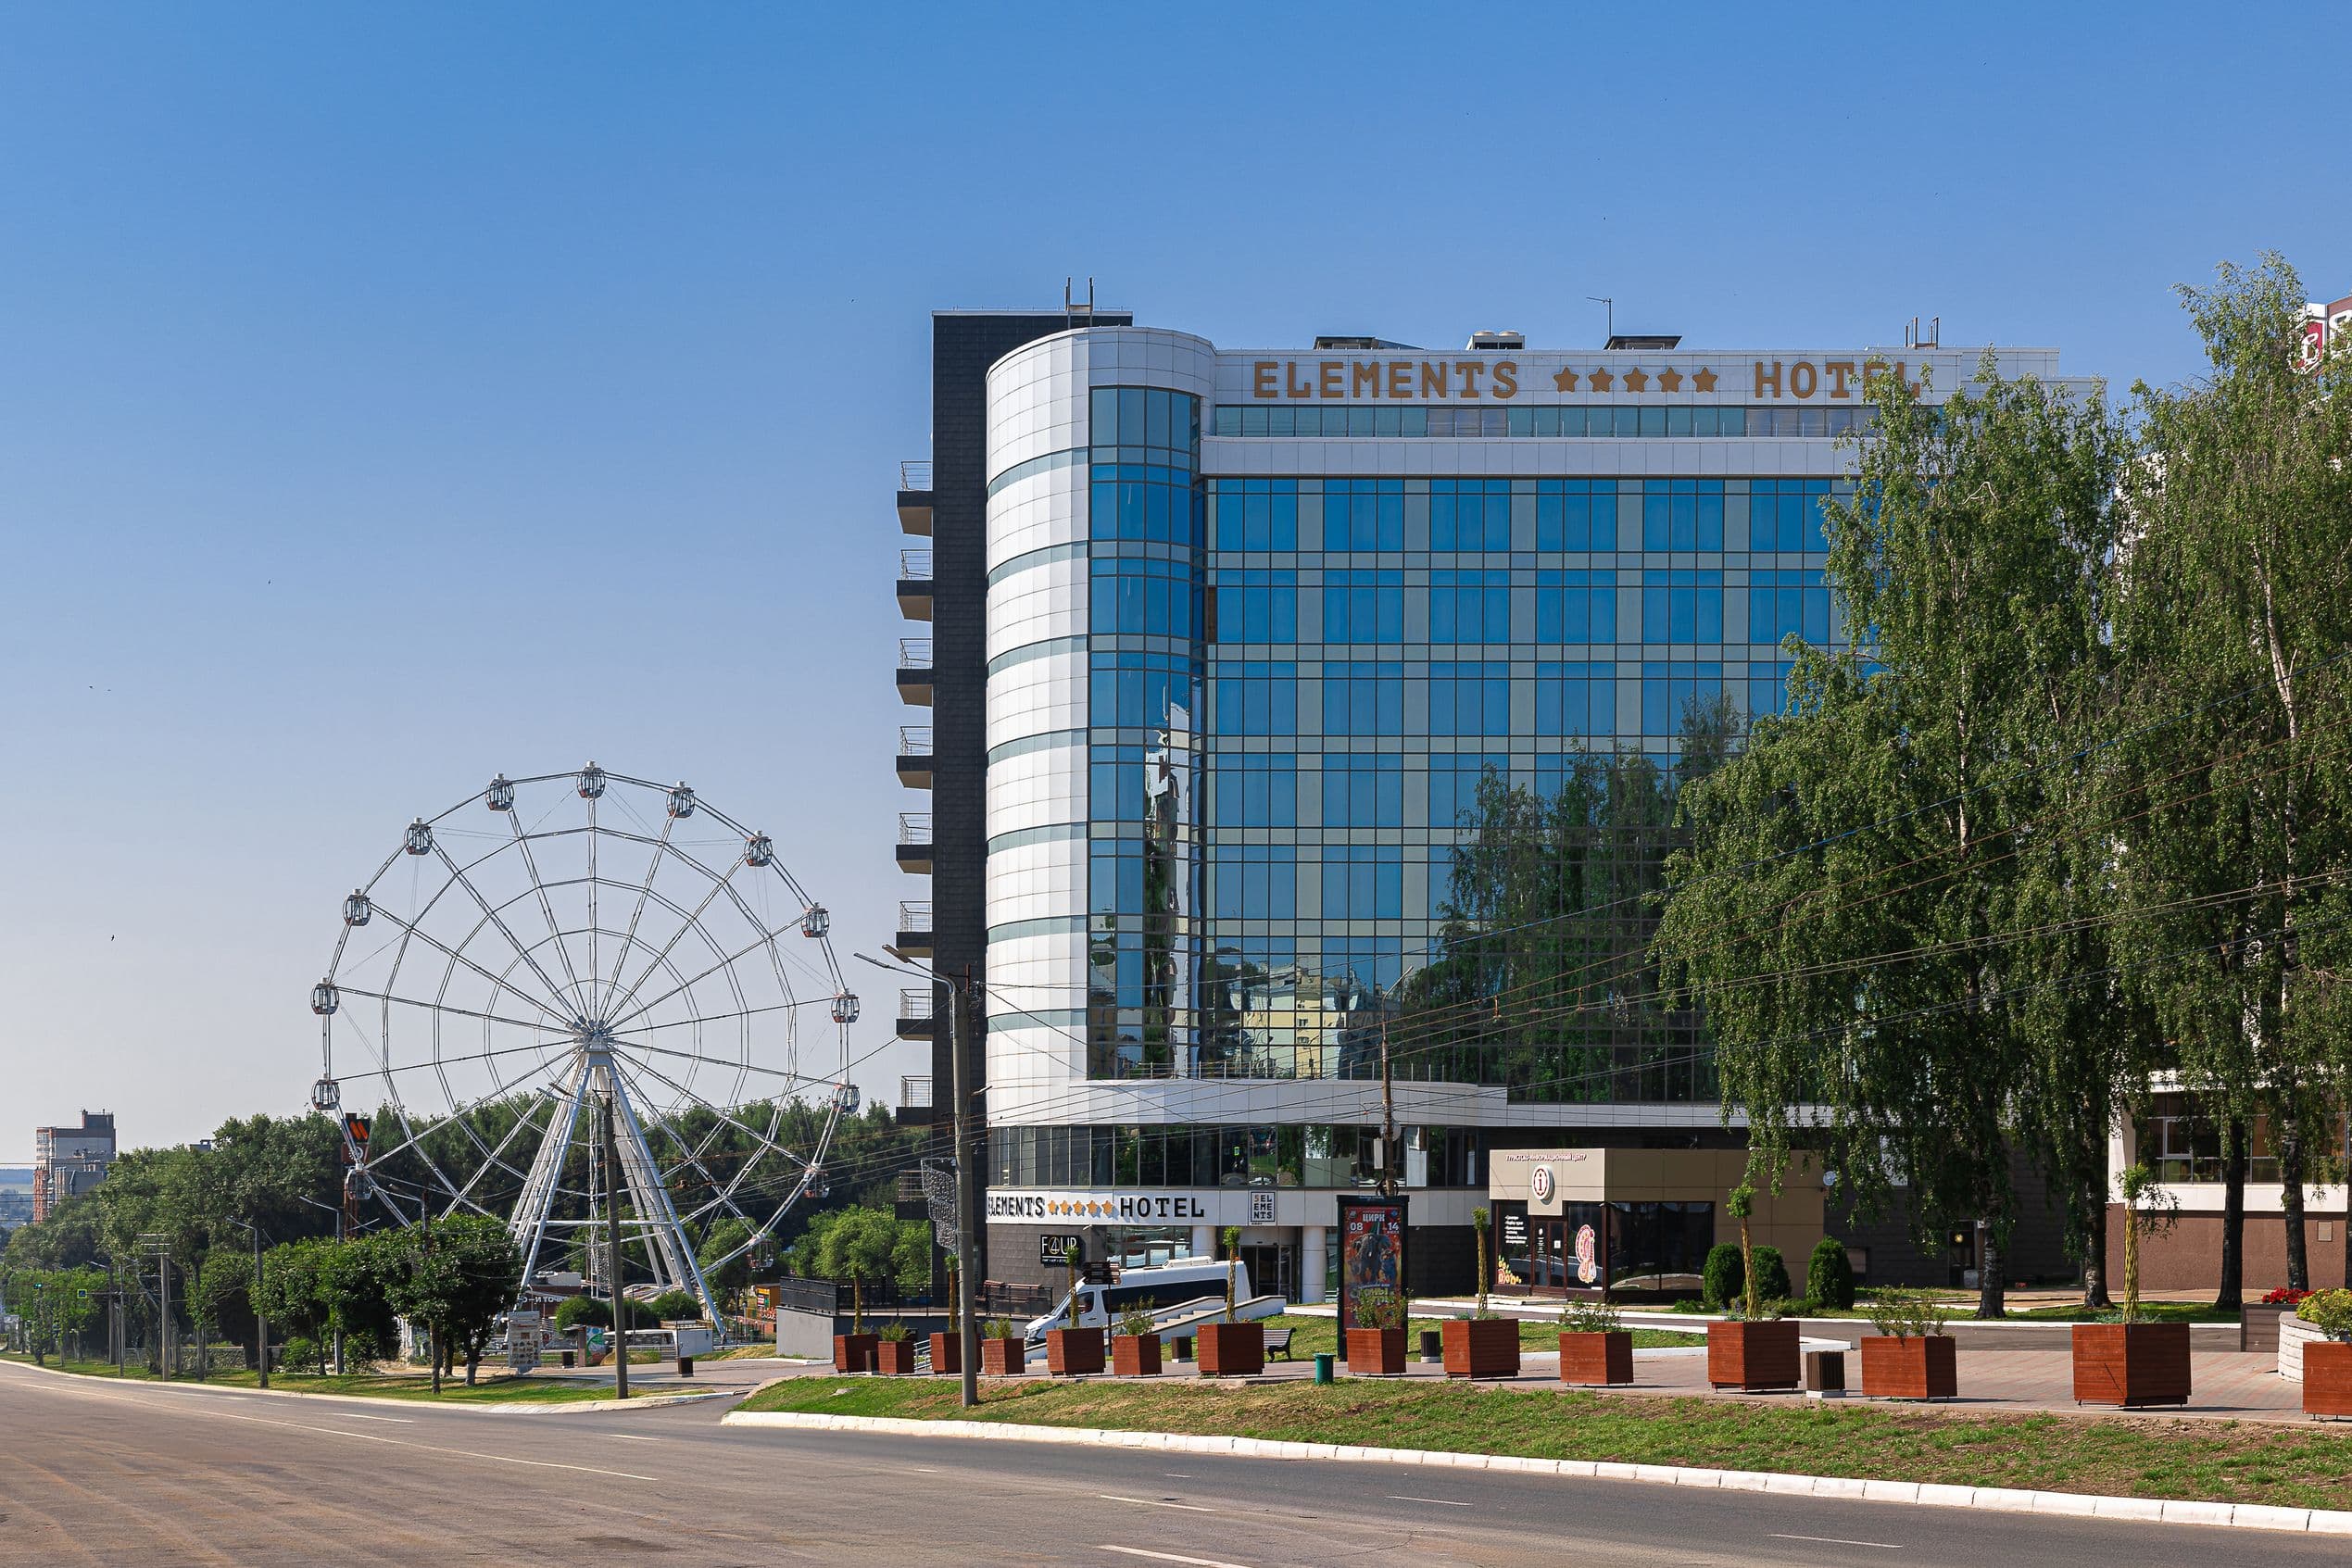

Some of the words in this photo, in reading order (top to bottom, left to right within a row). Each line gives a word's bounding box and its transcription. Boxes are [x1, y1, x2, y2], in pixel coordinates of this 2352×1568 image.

[1253, 361, 1518, 398] ELEMENTS
[1120, 1198, 1204, 1218] HOTEL
[1350, 1222, 1364, 1231] 08
[1388, 1222, 1400, 1231] 14
